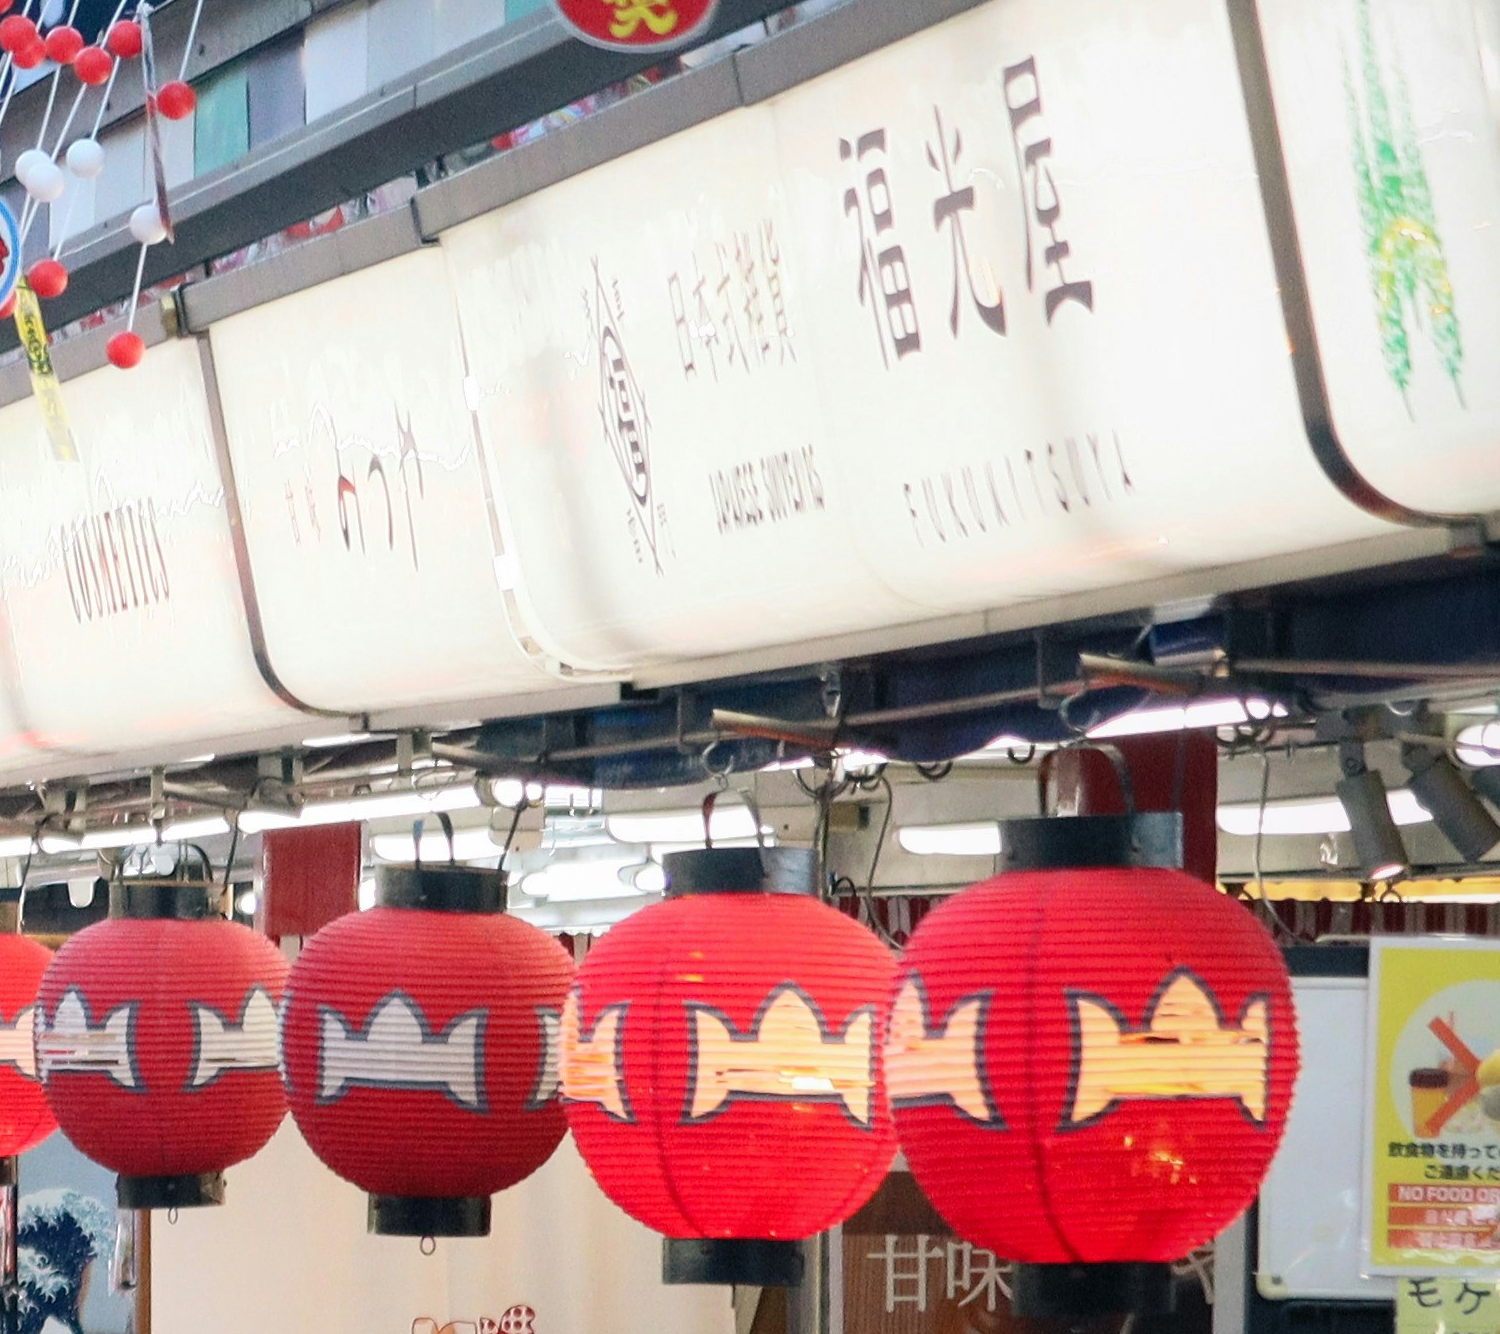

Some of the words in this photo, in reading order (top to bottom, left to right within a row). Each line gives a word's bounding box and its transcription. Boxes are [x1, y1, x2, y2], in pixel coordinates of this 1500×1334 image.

[838, 56, 1093, 371] 福光屋
[62, 495, 172, 625] COSMETICS
[1399, 1188, 1424, 1201] NO
[1426, 1188, 1473, 1201] FOOD
[866, 1234, 1014, 1312] 甘味
